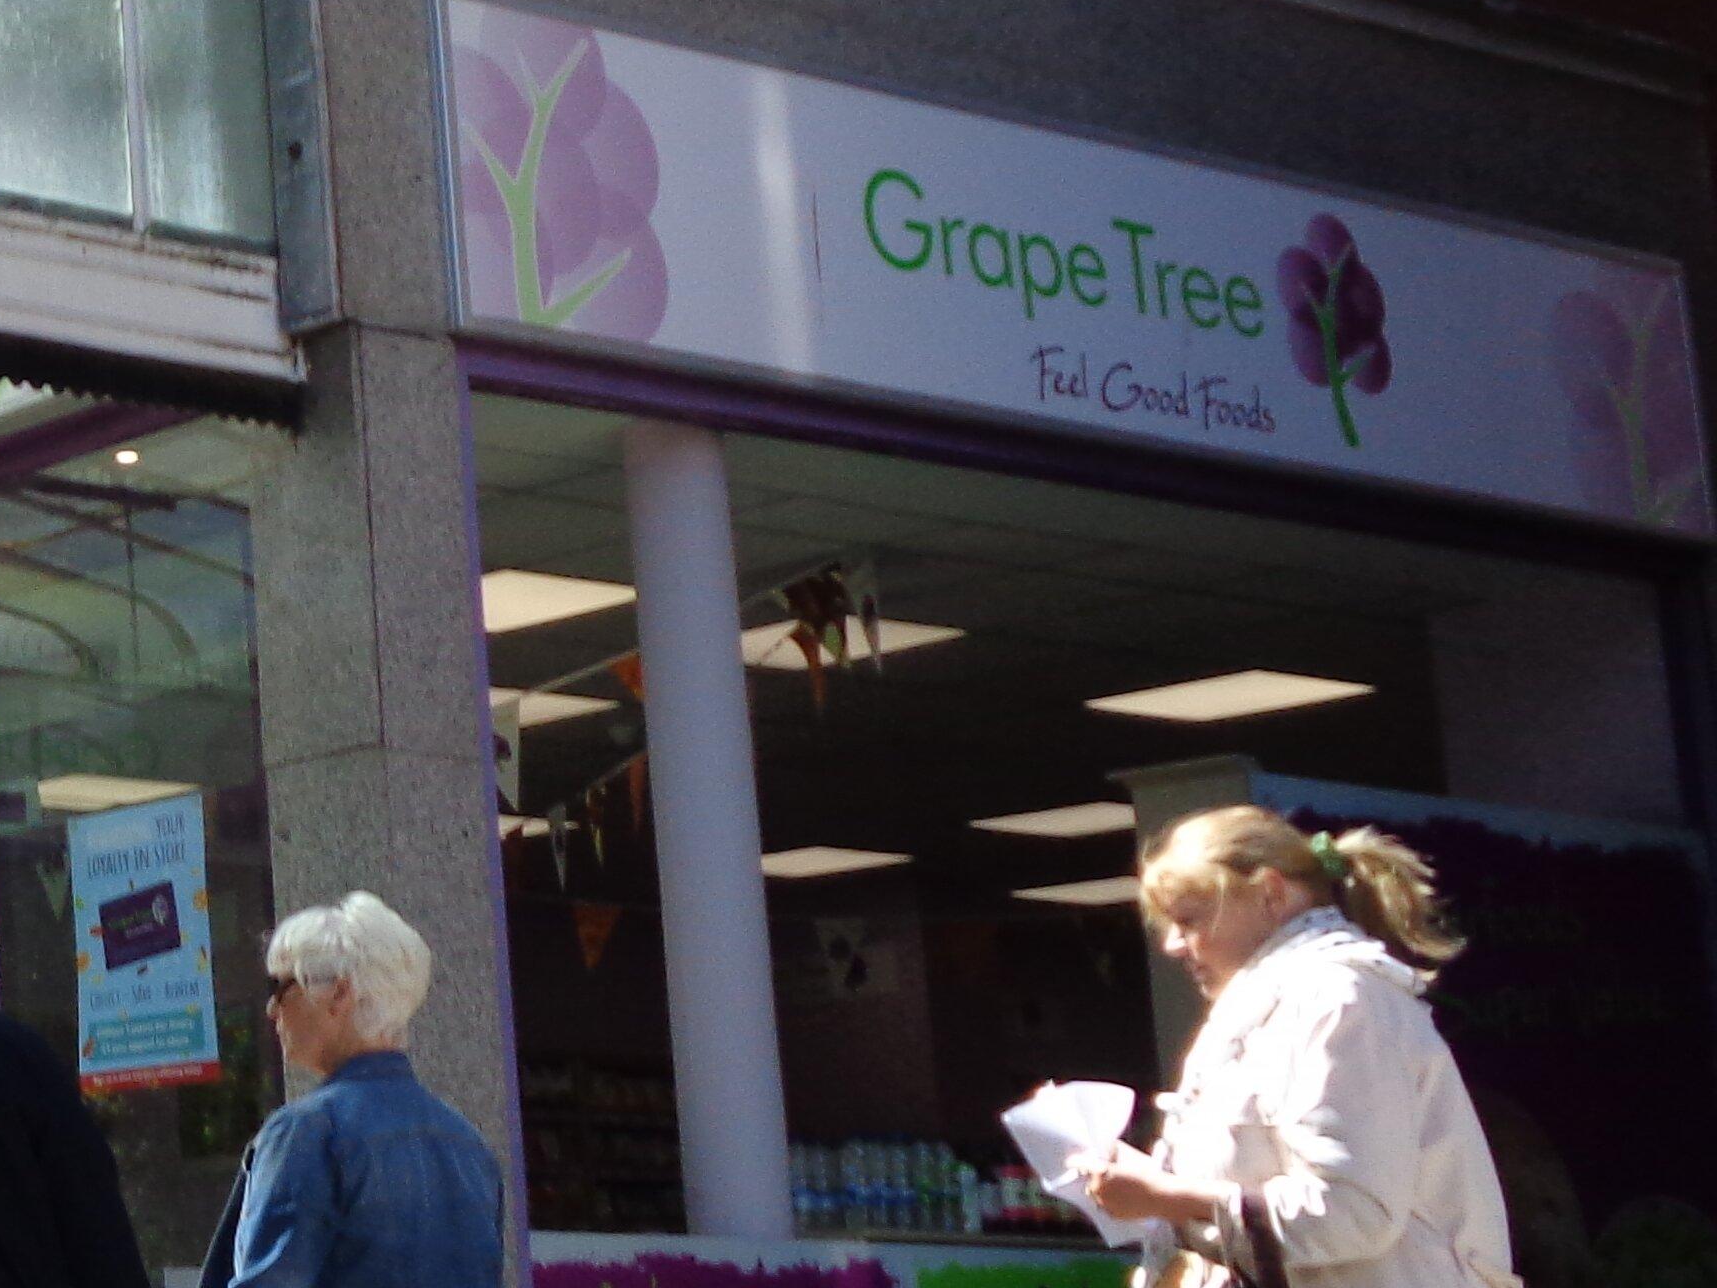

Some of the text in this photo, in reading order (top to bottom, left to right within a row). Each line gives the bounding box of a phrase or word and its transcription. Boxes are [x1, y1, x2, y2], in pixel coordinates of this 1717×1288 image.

[864, 168, 1265, 338] Grape Tree
[1032, 345, 1277, 434] Feel Good Foods
